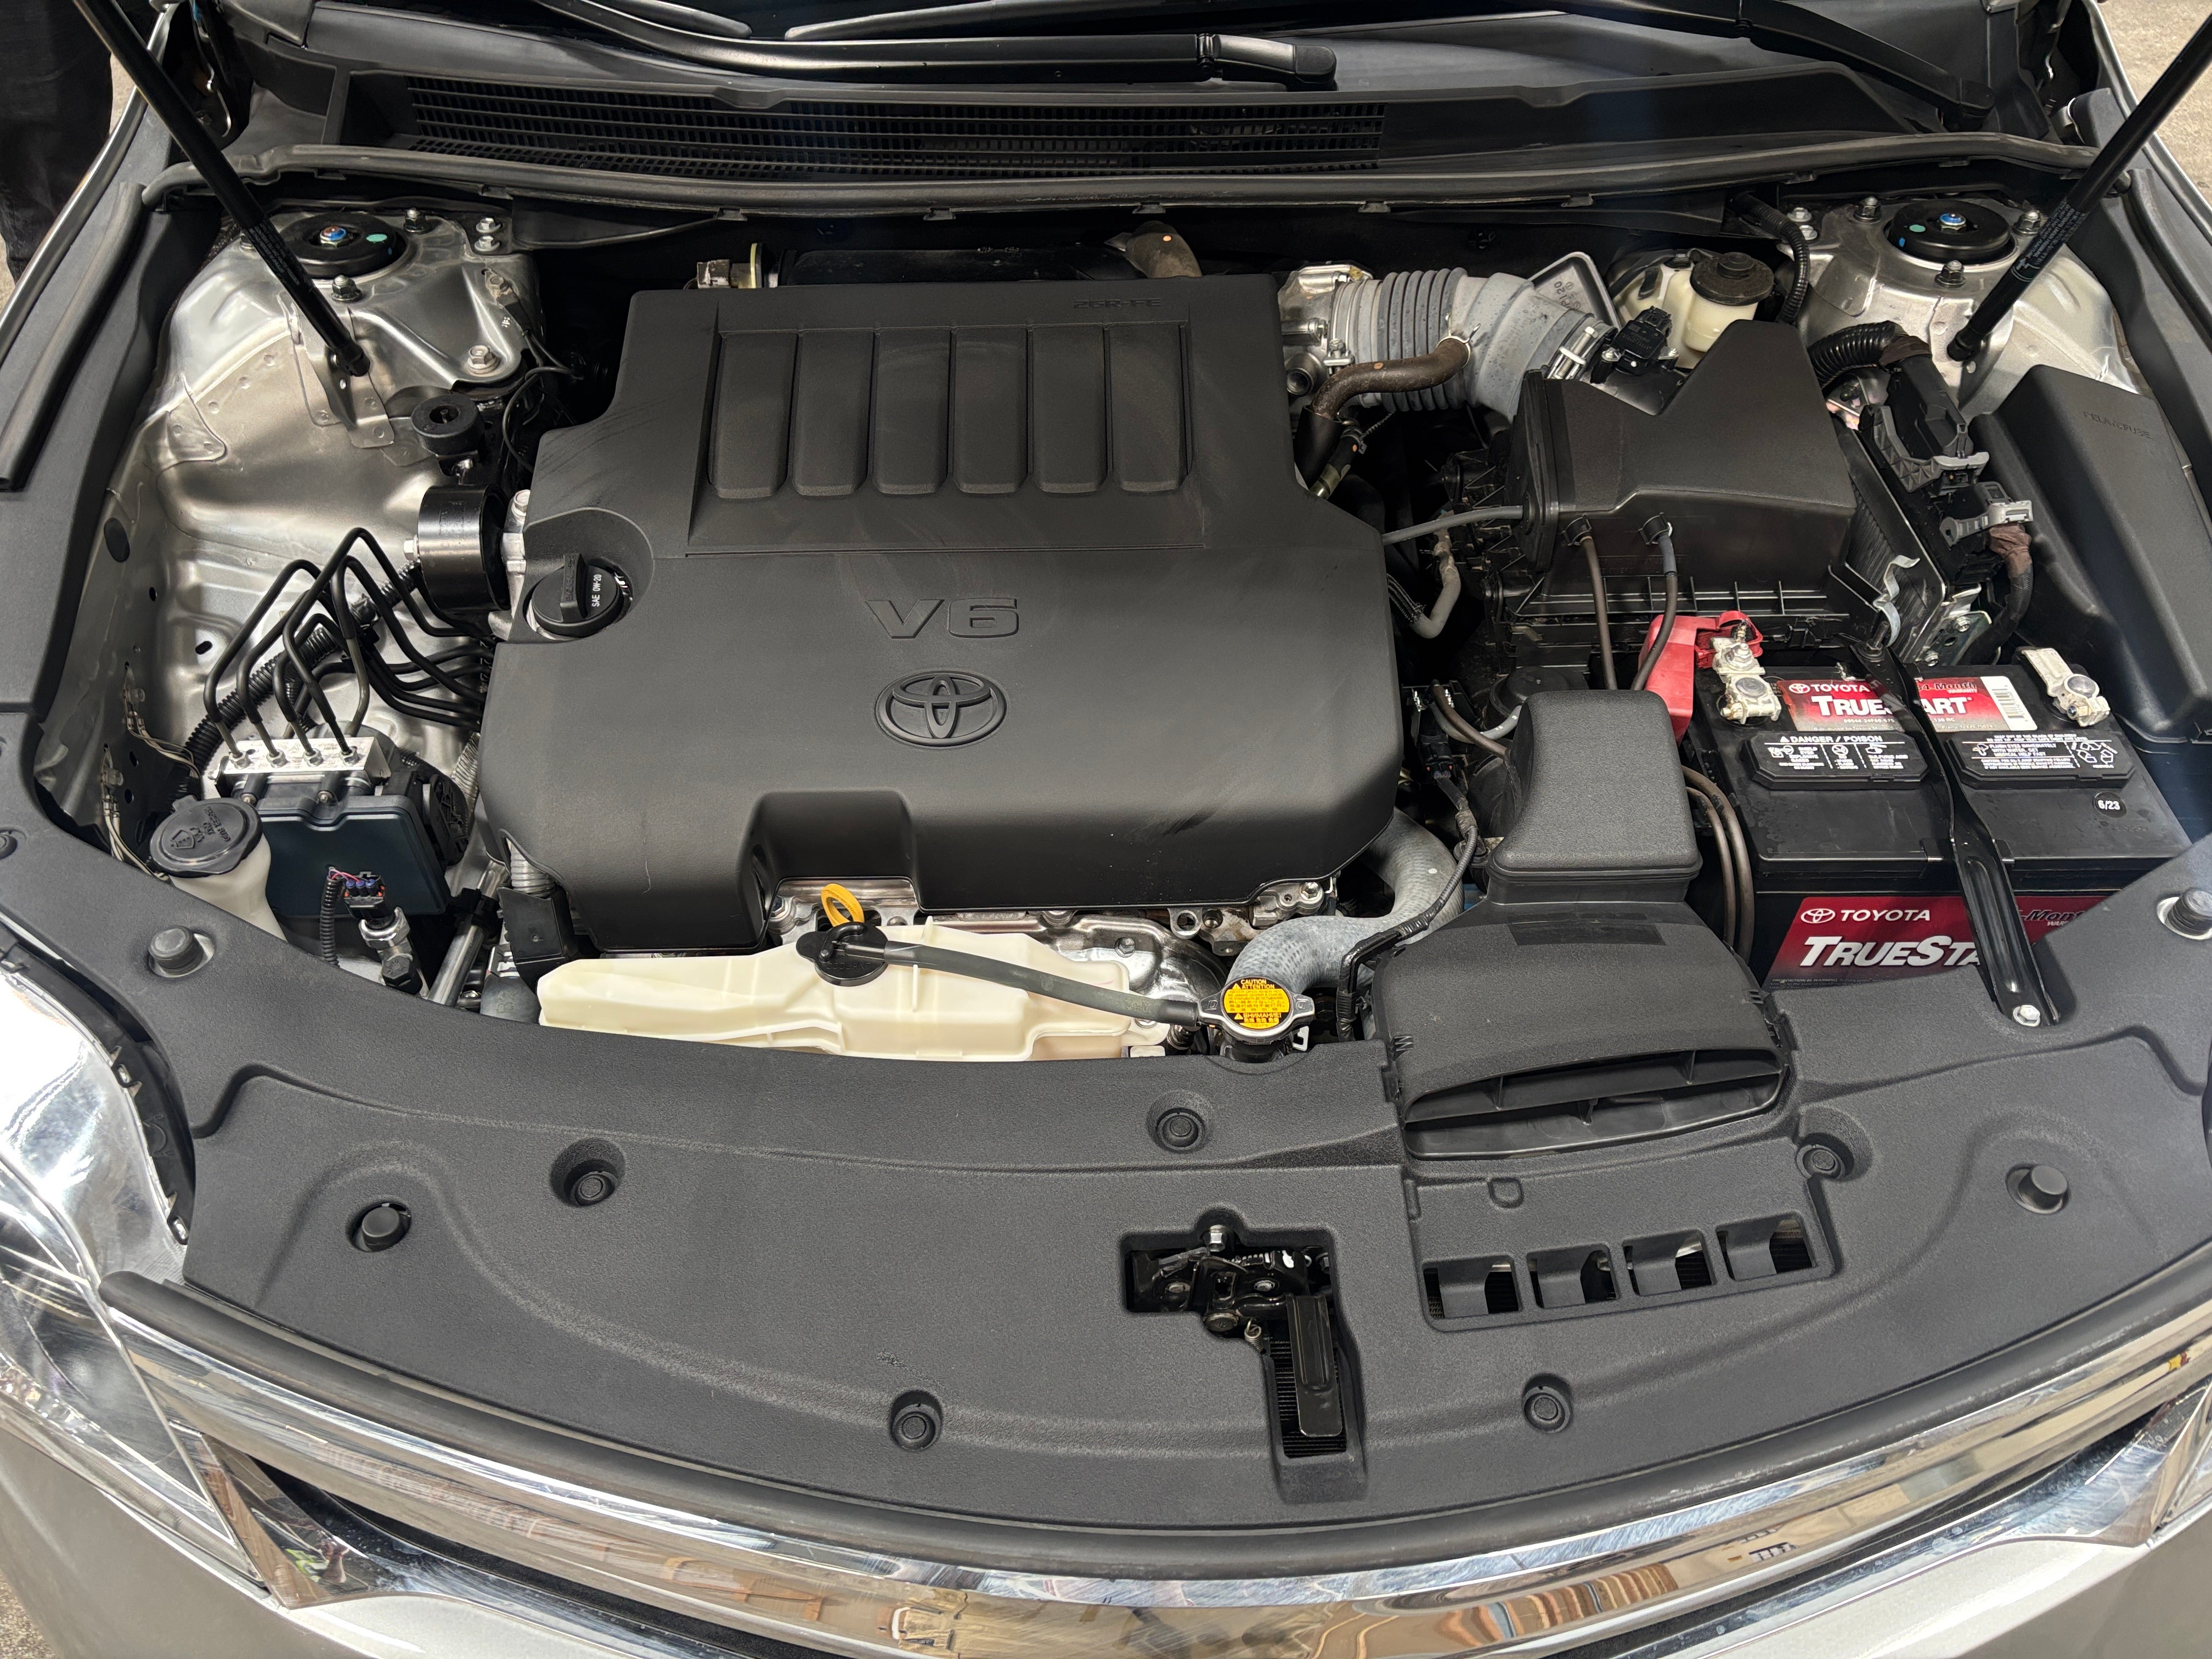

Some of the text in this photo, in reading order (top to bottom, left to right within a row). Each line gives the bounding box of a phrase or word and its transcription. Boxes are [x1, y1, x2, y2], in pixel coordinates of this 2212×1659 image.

[591, 574, 602, 607] SAE 0W-20
[865, 597, 1019, 639] V6
[1810, 684, 1870, 692] TOYOTA
[2098, 800, 2120, 810] 6/23
[1840, 910, 1931, 922] TOYOTA
[1799, 936, 1980, 967] TRUESTA
